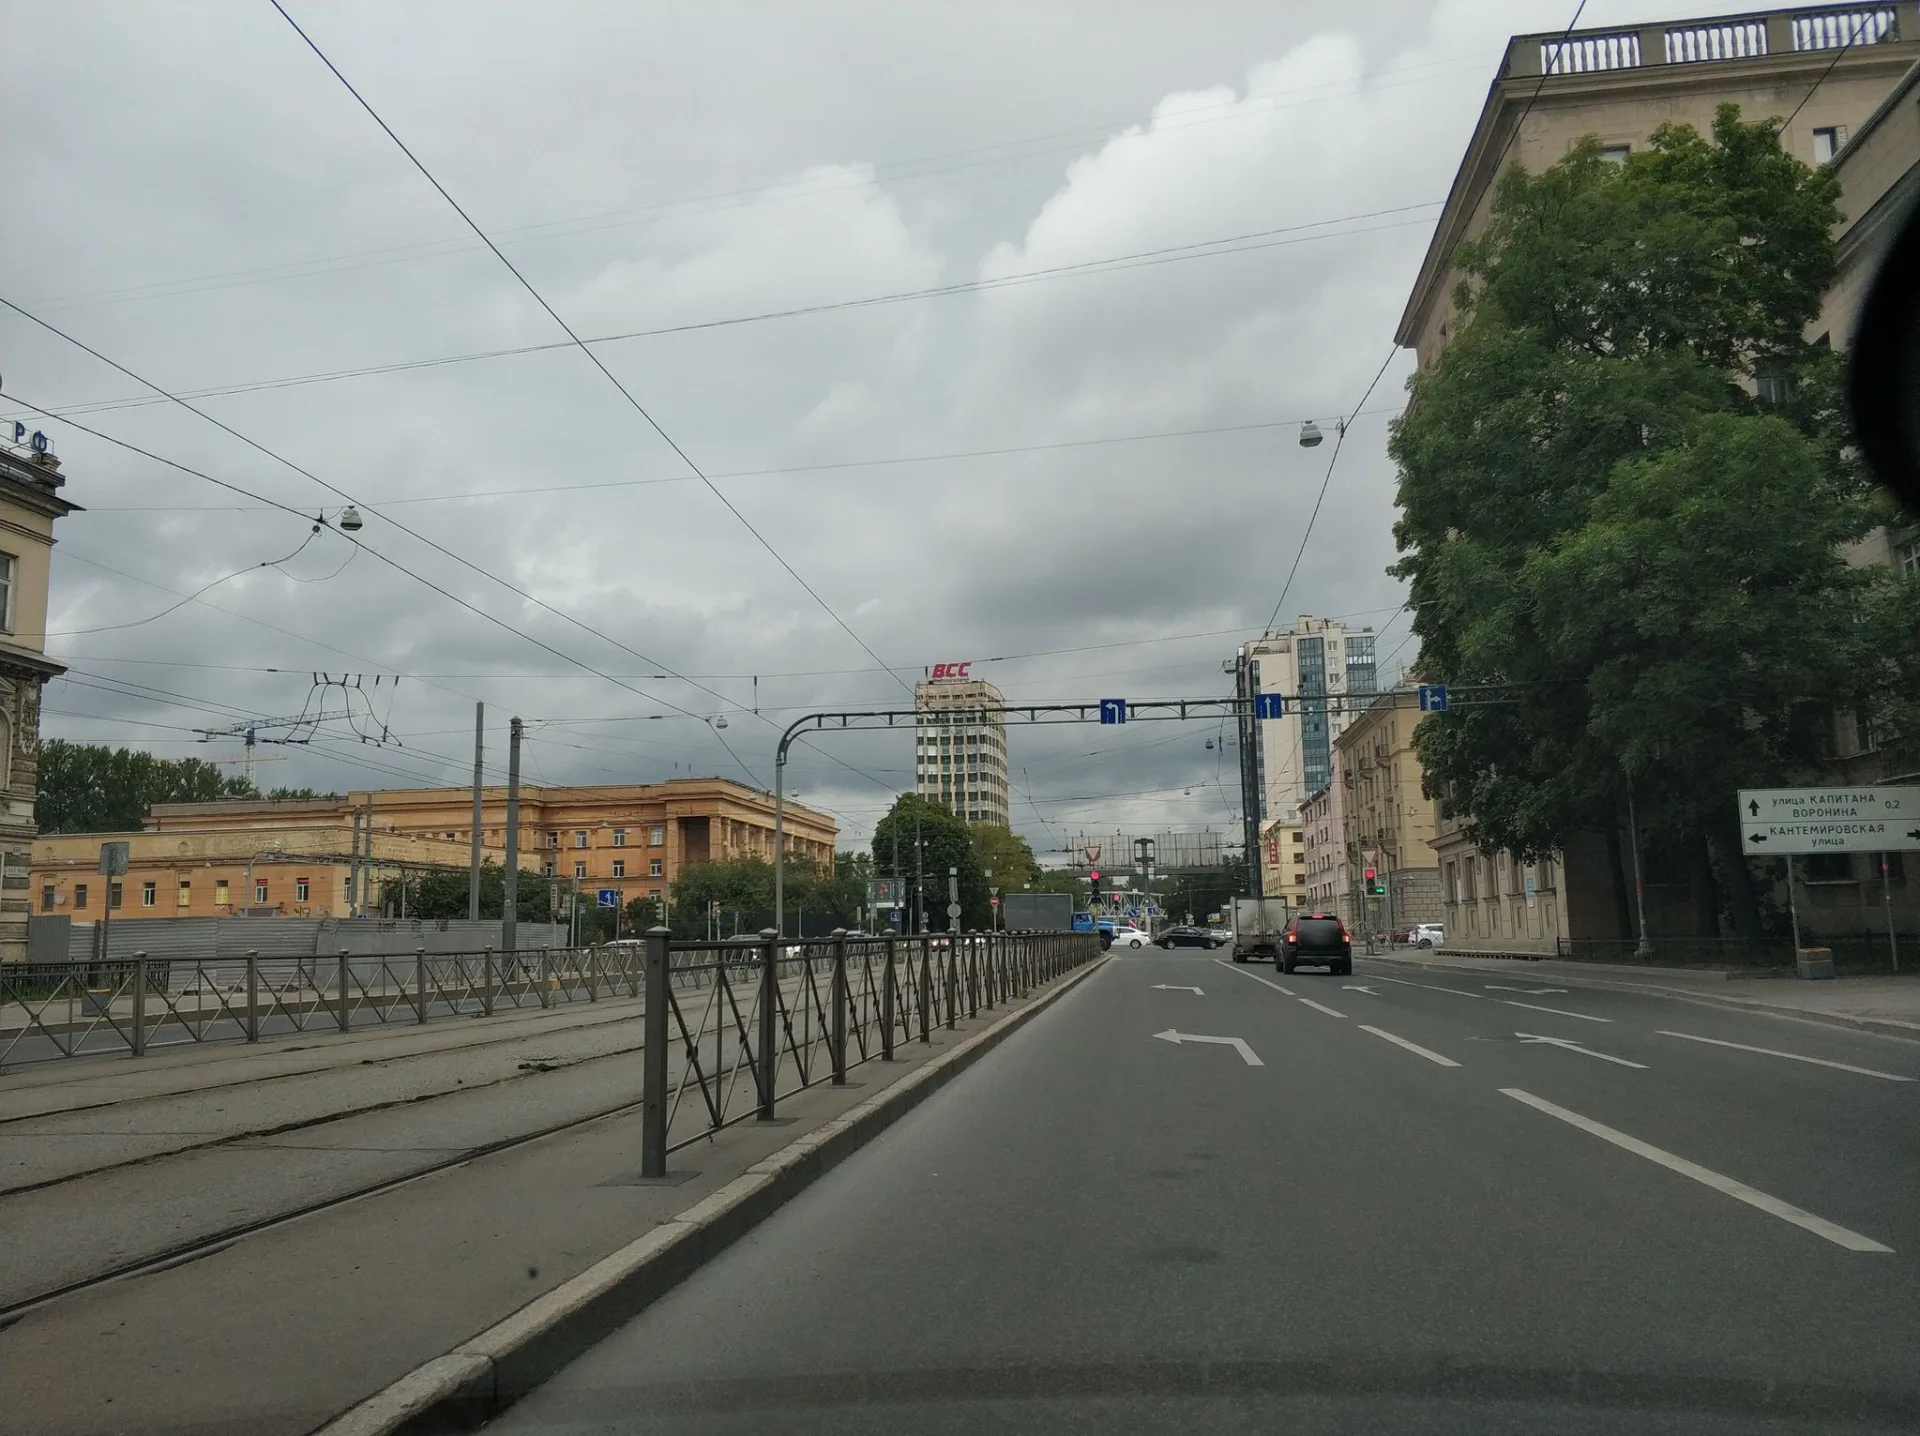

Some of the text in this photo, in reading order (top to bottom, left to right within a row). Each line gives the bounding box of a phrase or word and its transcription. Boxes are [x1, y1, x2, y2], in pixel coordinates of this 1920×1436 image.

[1772, 794, 1876, 807] улица КАПИТАНА
[1793, 808, 1858, 817] ВОРОНИНА
[1769, 824, 1885, 836] КАНТЕМИРОВСКАЯ
[1812, 838, 1845, 847] улица
